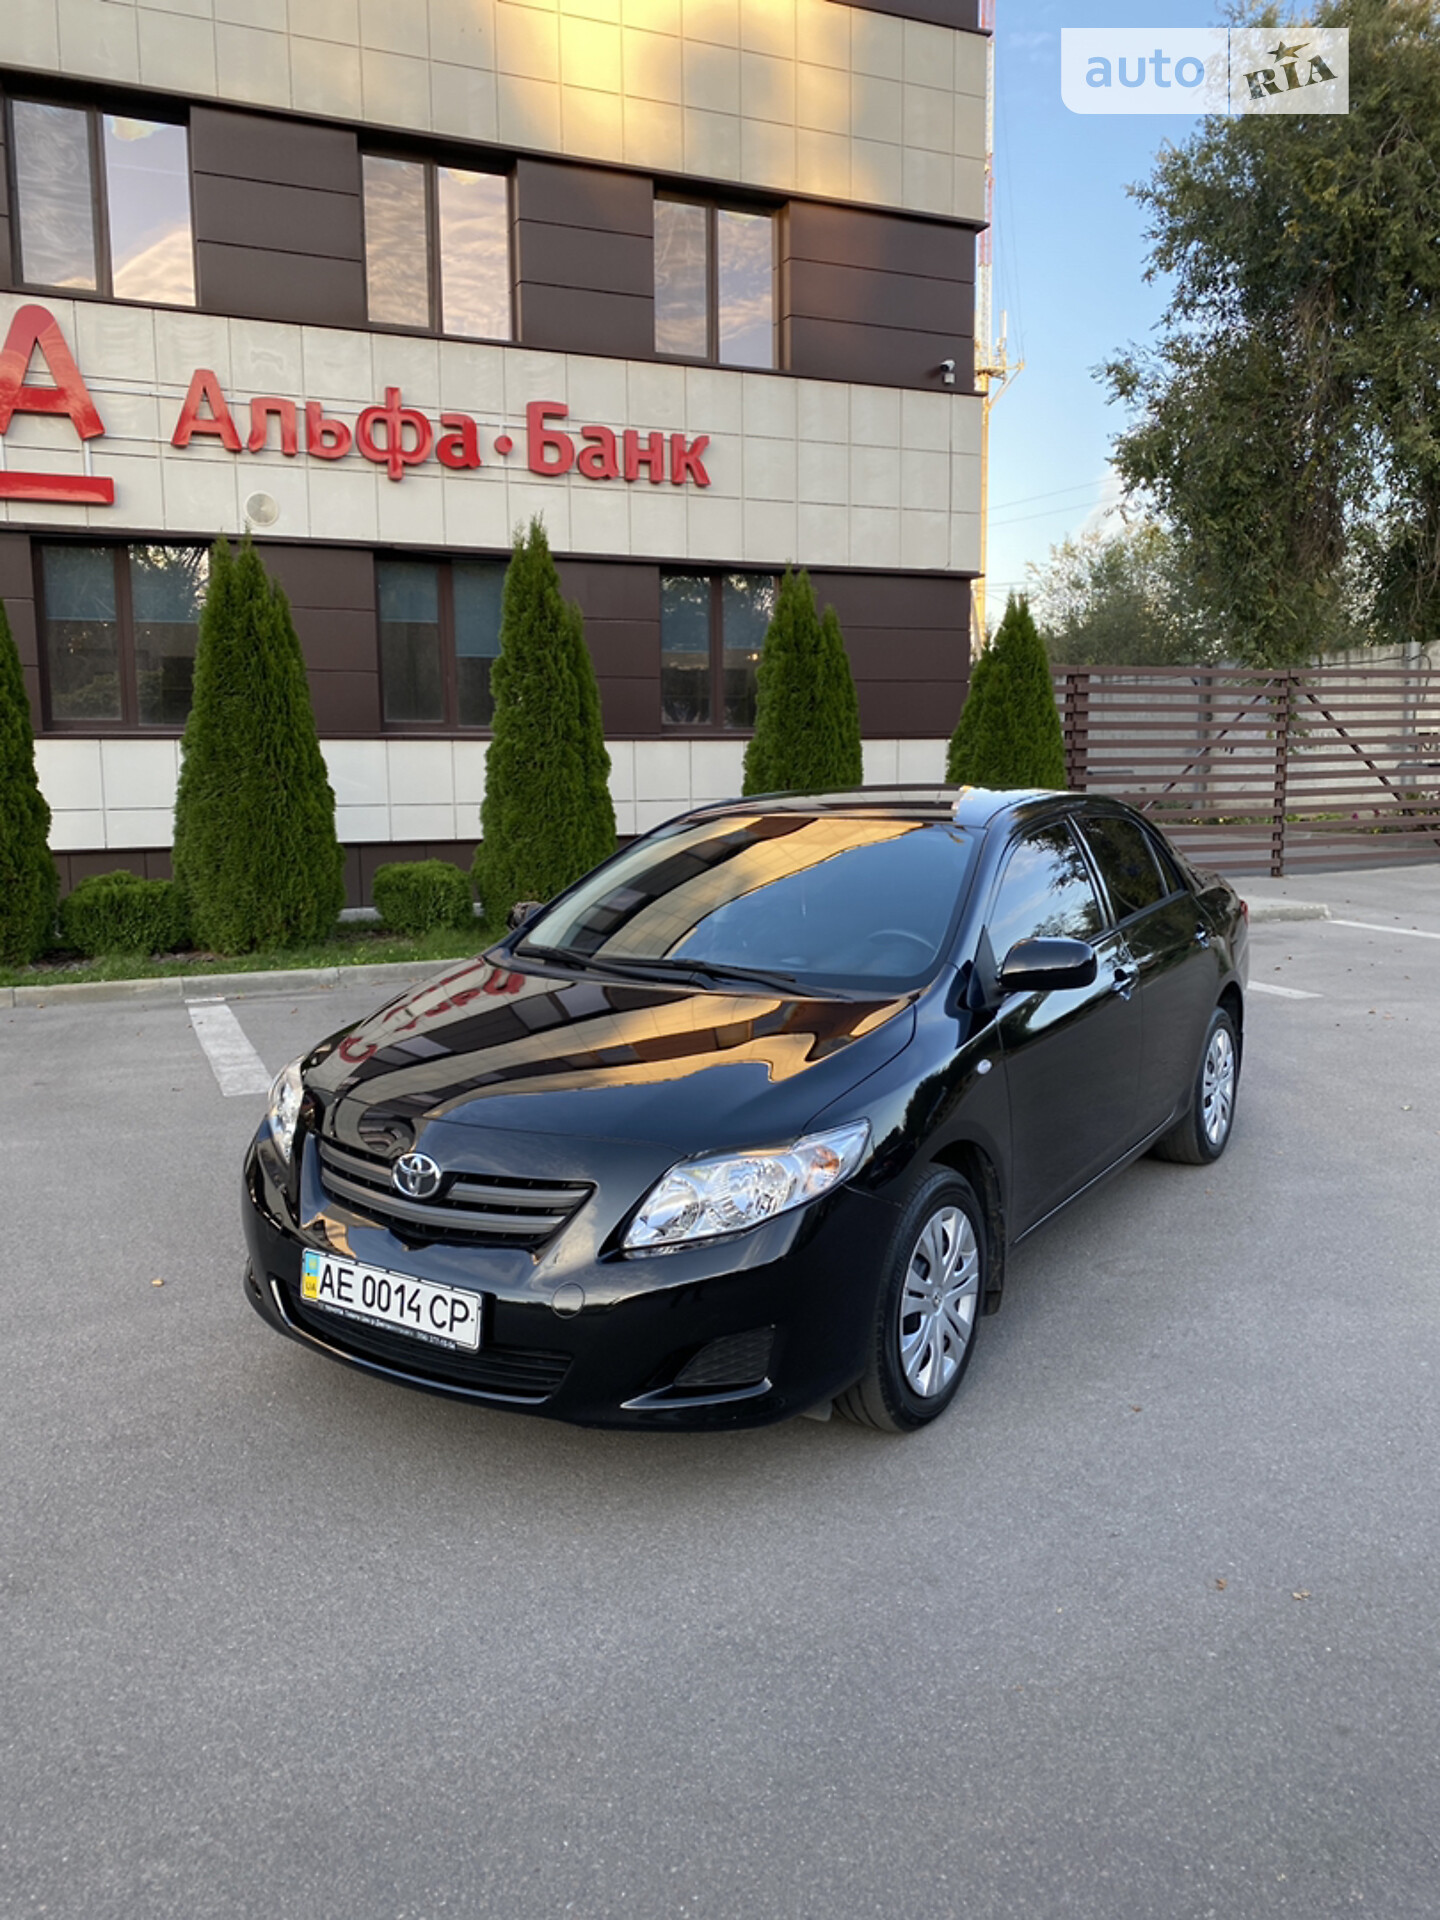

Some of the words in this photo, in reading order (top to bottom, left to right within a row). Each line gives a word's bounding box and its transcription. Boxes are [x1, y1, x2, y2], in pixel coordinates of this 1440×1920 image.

[171, 368, 481, 482] Альфа
[526, 400, 711, 487] Банк
[319, 1263, 354, 1303] AE
[362, 1275, 422, 1323] 0014
[429, 1295, 470, 1332] CP
